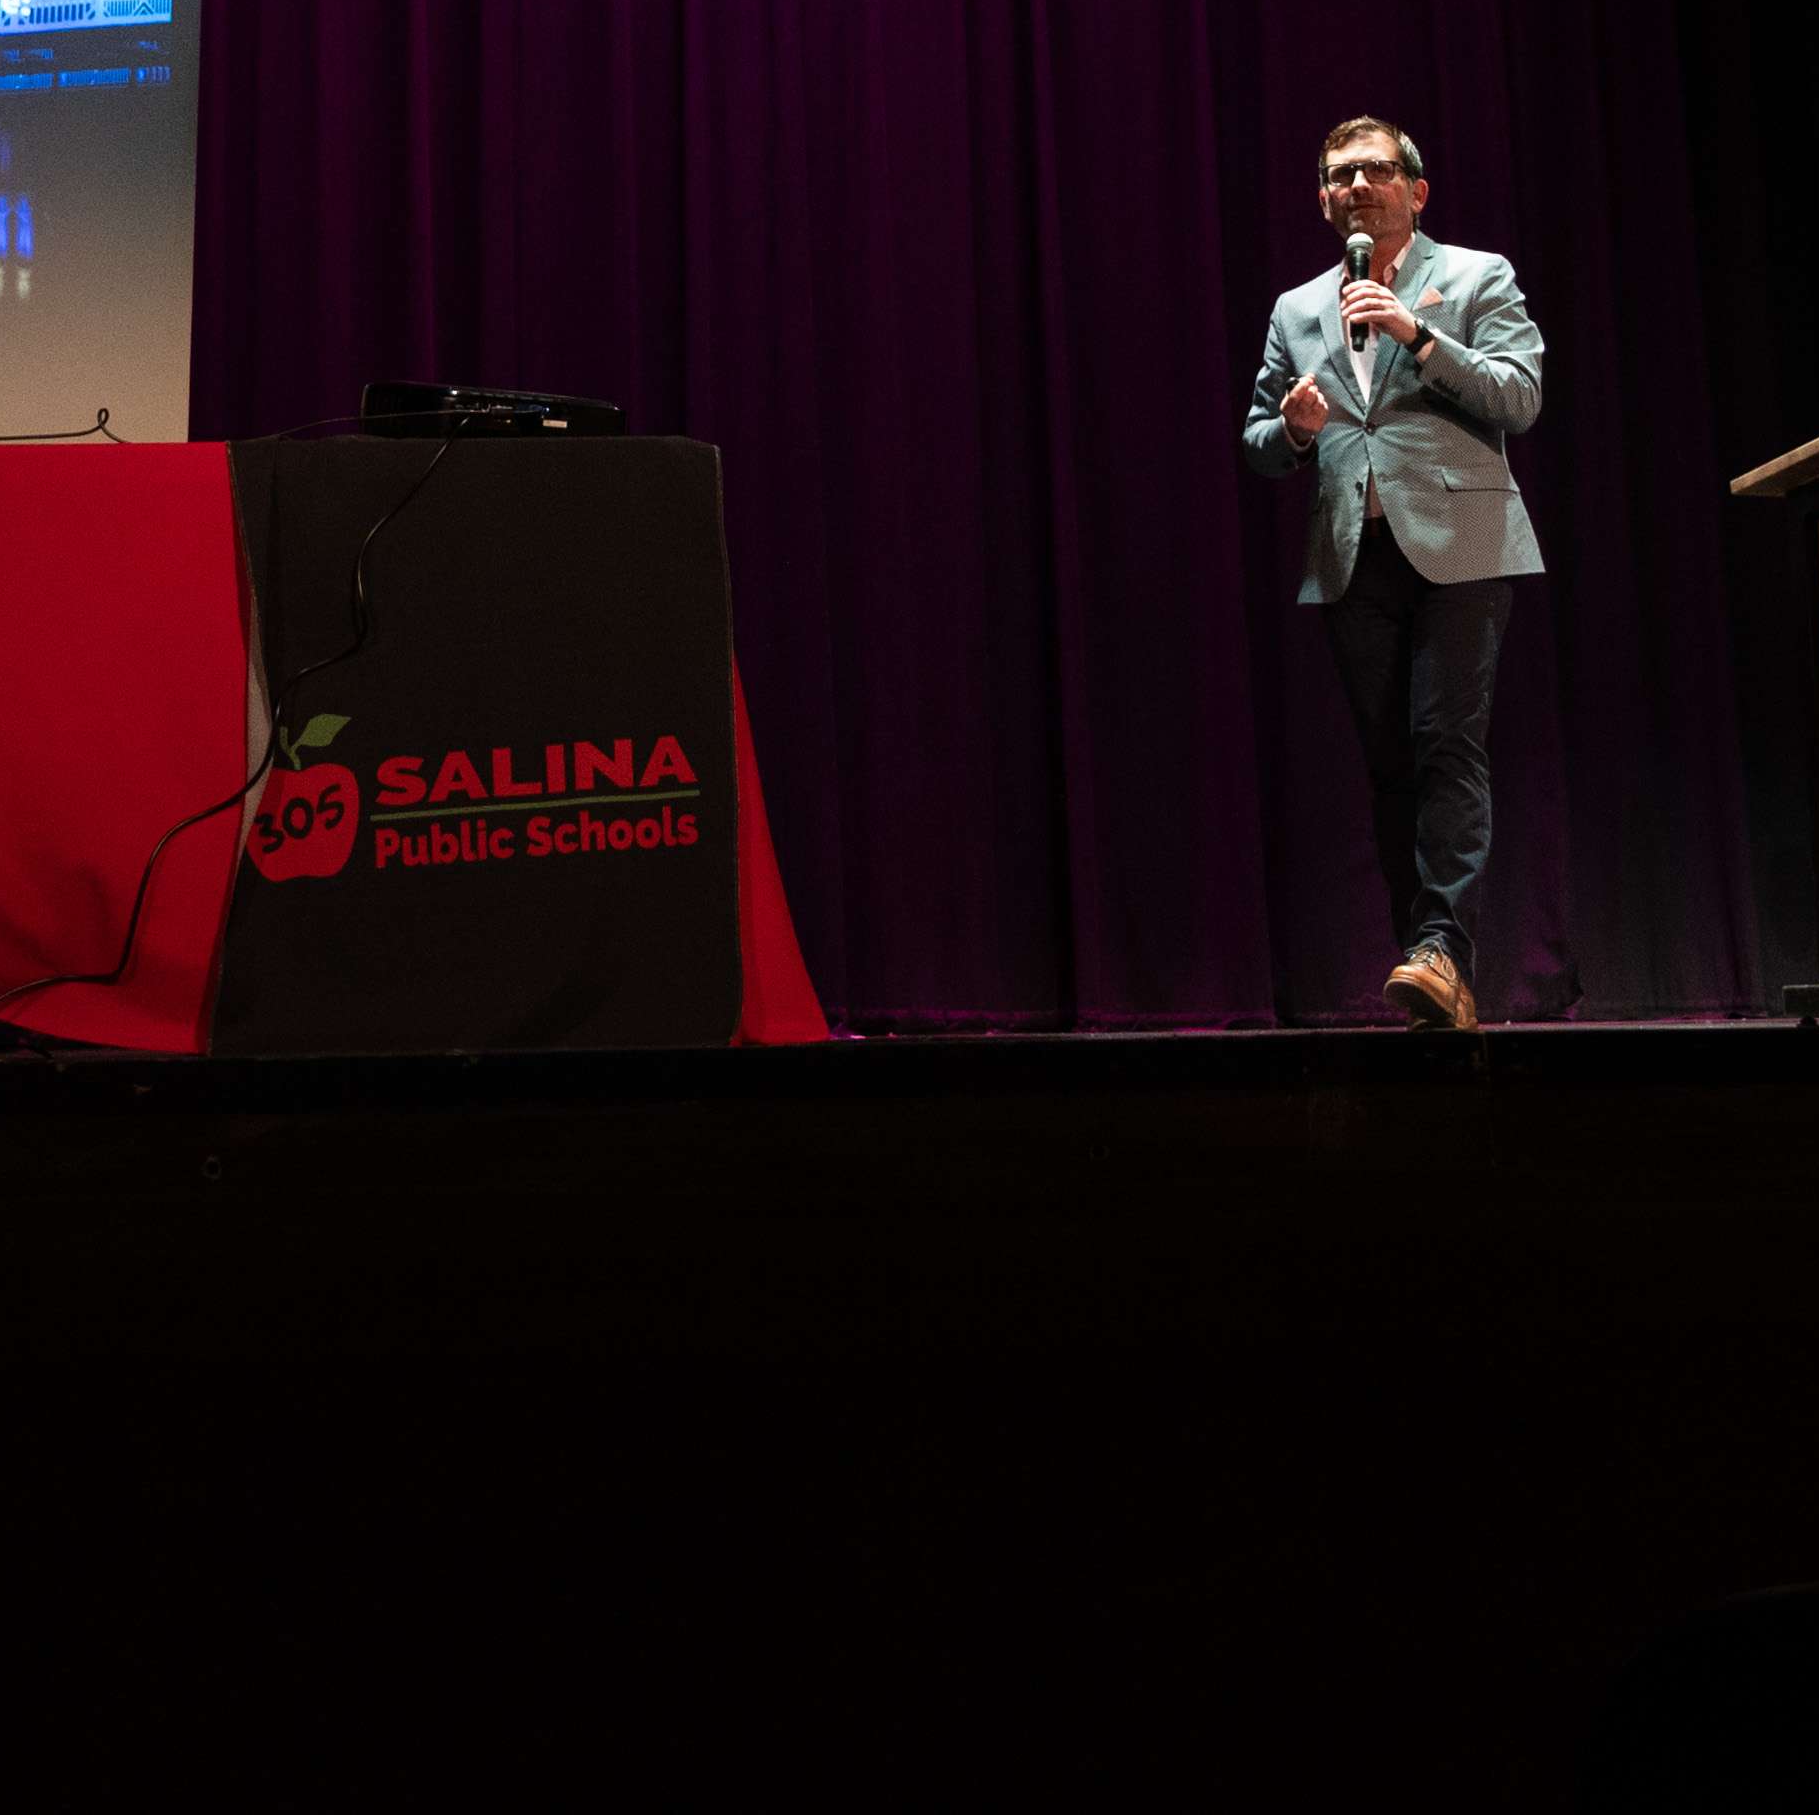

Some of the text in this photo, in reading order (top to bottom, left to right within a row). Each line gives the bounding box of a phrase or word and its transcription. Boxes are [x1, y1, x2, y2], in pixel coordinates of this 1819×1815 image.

[376, 735, 699, 806] SALINA
[254, 784, 345, 854] 305
[376, 806, 700, 869] Public Schools
